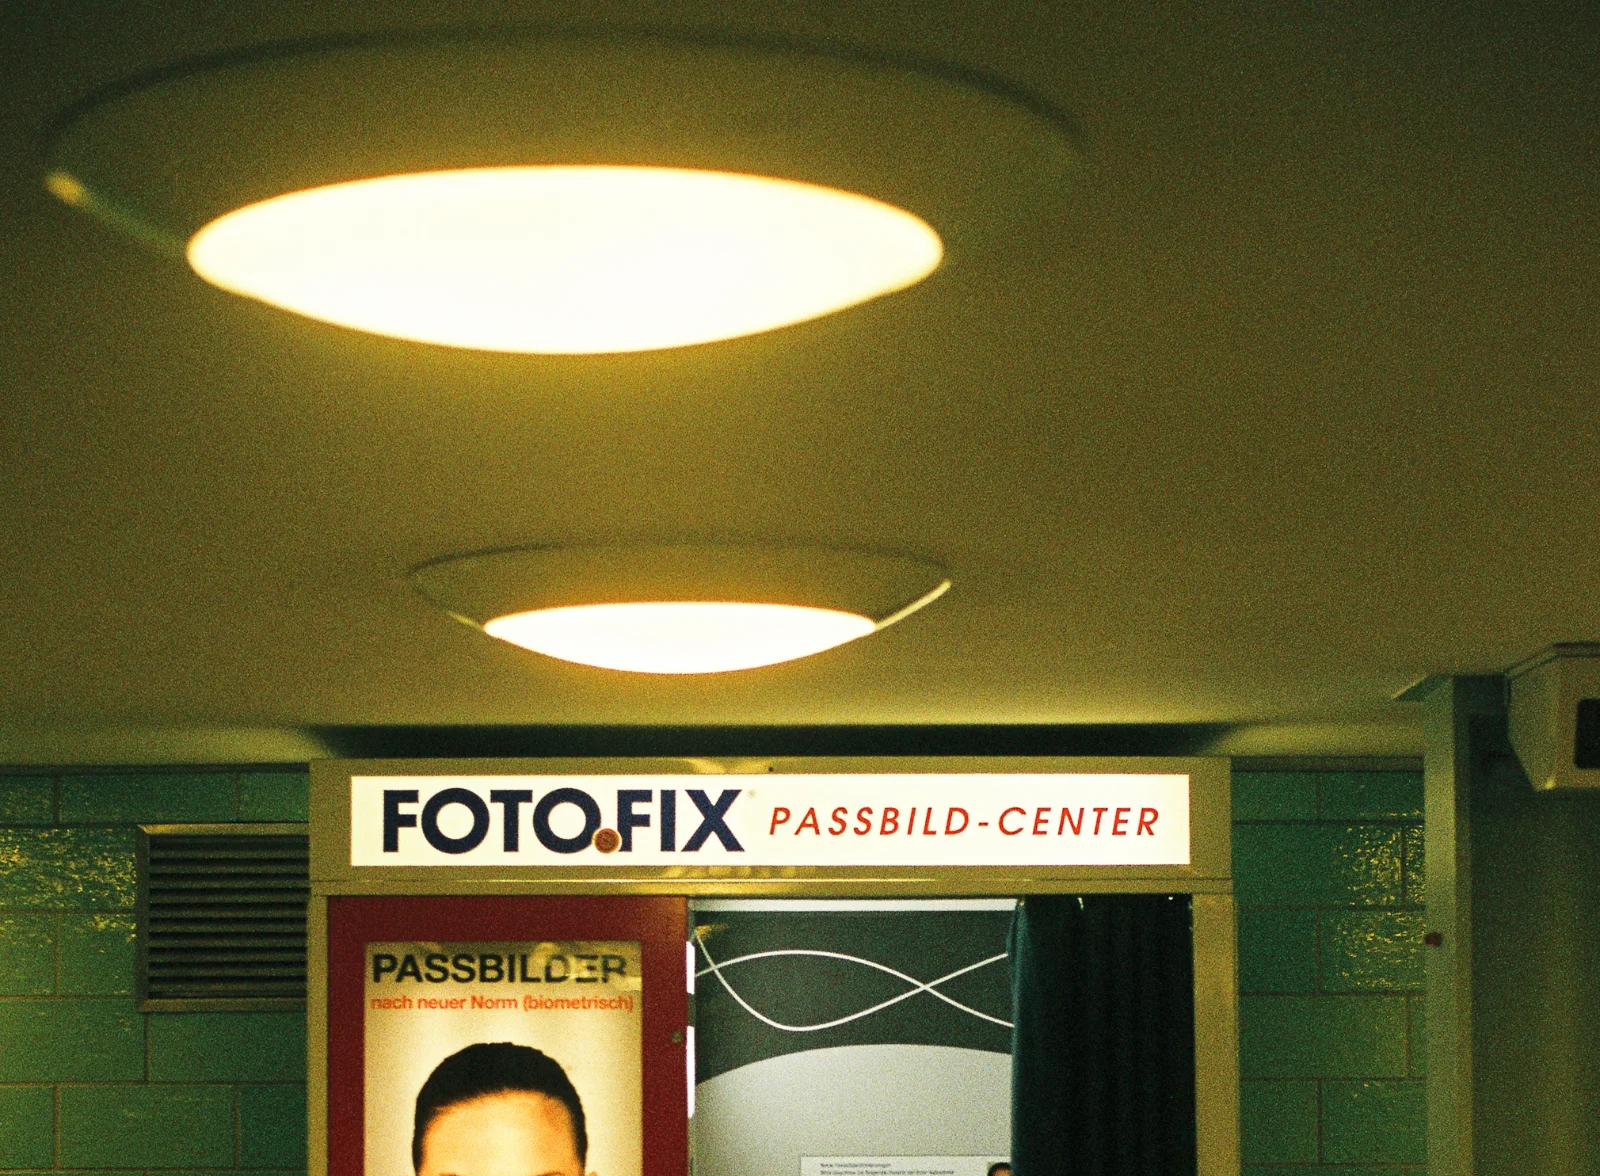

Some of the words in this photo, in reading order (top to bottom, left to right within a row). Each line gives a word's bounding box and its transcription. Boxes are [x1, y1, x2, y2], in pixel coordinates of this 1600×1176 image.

[768, 806, 1161, 838] PASSBILD-CENTER
[373, 953, 627, 983] PASSBILDER
[370, 995, 412, 1011] nach
[417, 998, 464, 1011] neuer
[470, 996, 518, 1010] Norm
[523, 995, 634, 1012] (biometrisch)
